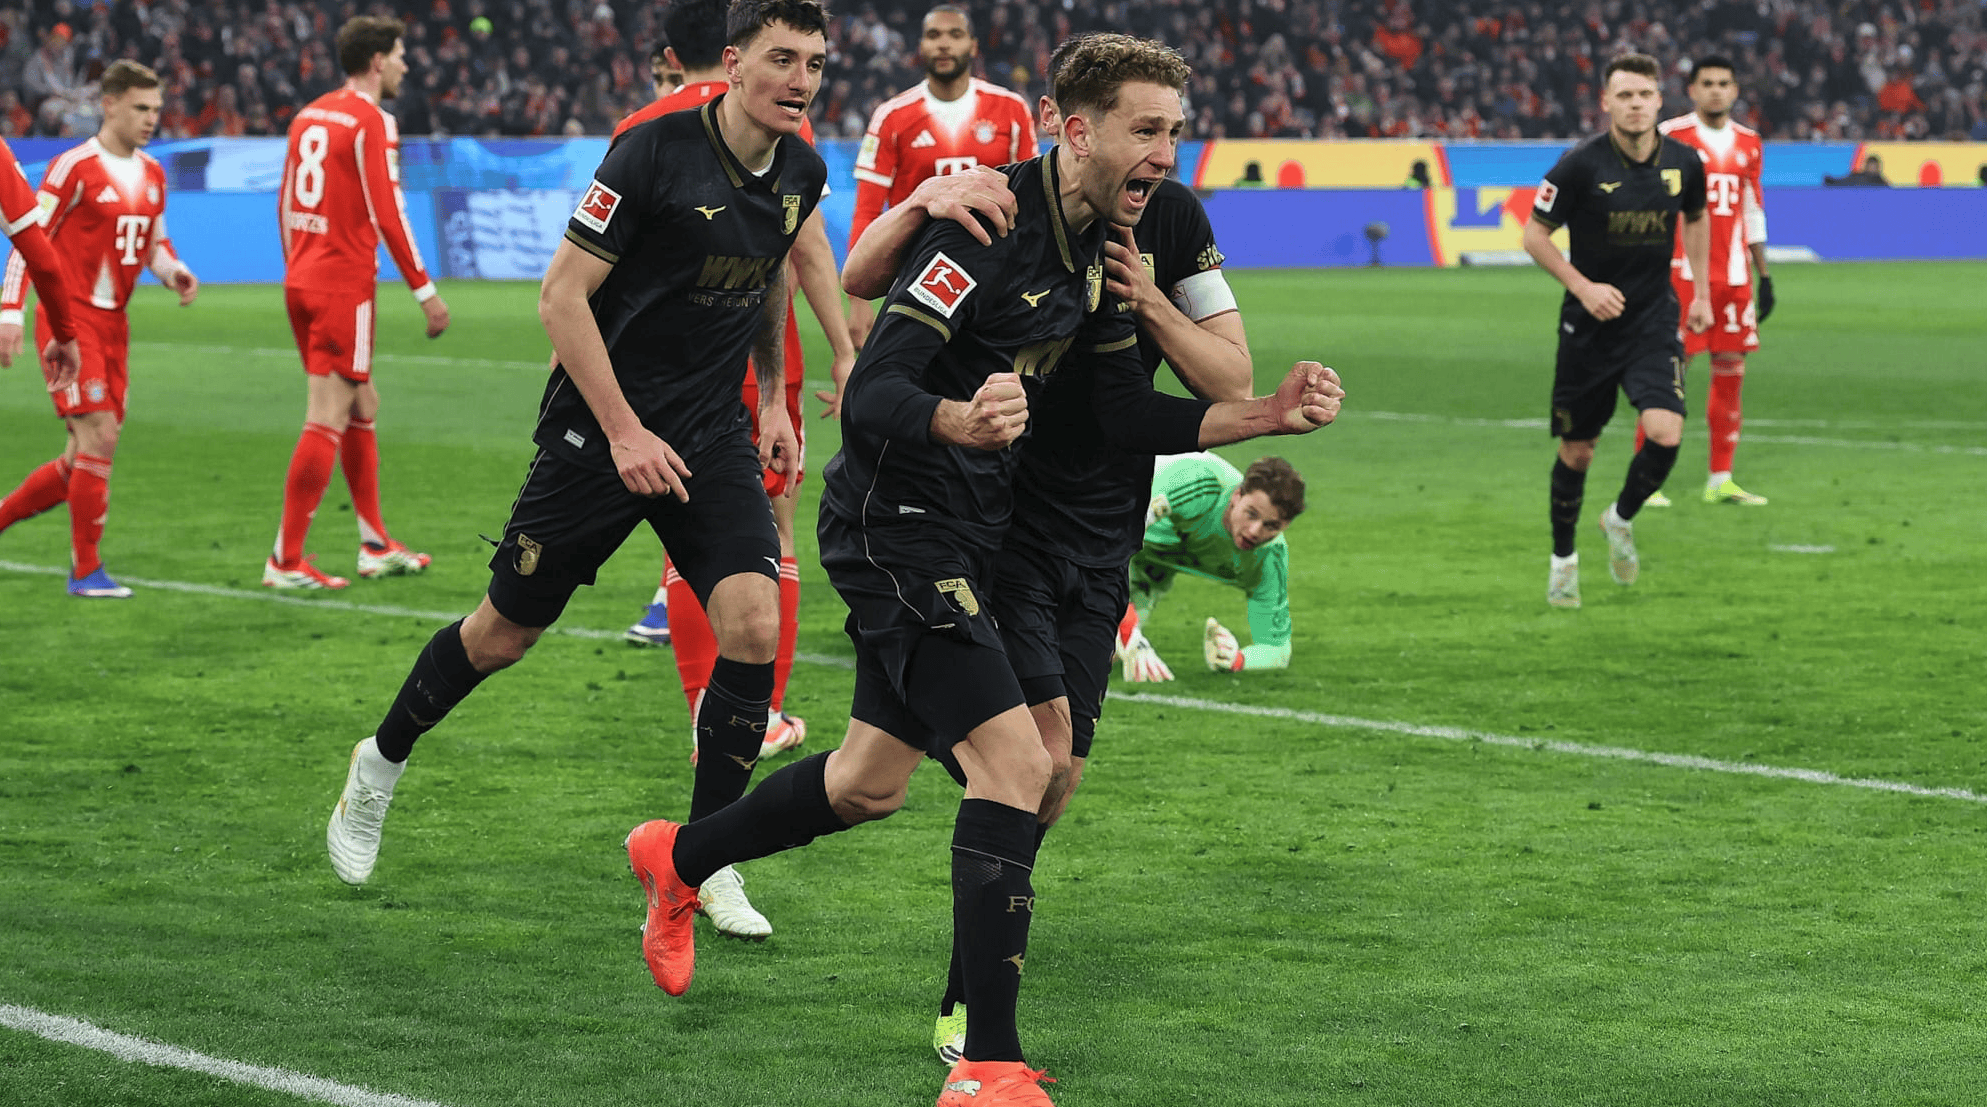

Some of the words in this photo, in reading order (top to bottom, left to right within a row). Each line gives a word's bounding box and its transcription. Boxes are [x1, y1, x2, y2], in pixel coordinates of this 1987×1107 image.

[296, 124, 329, 208] 8
[1706, 172, 1739, 216] T
[115, 215, 150, 265] T
[697, 255, 777, 289] WWK
[913, 286, 947, 315] BUNDESLIGA
